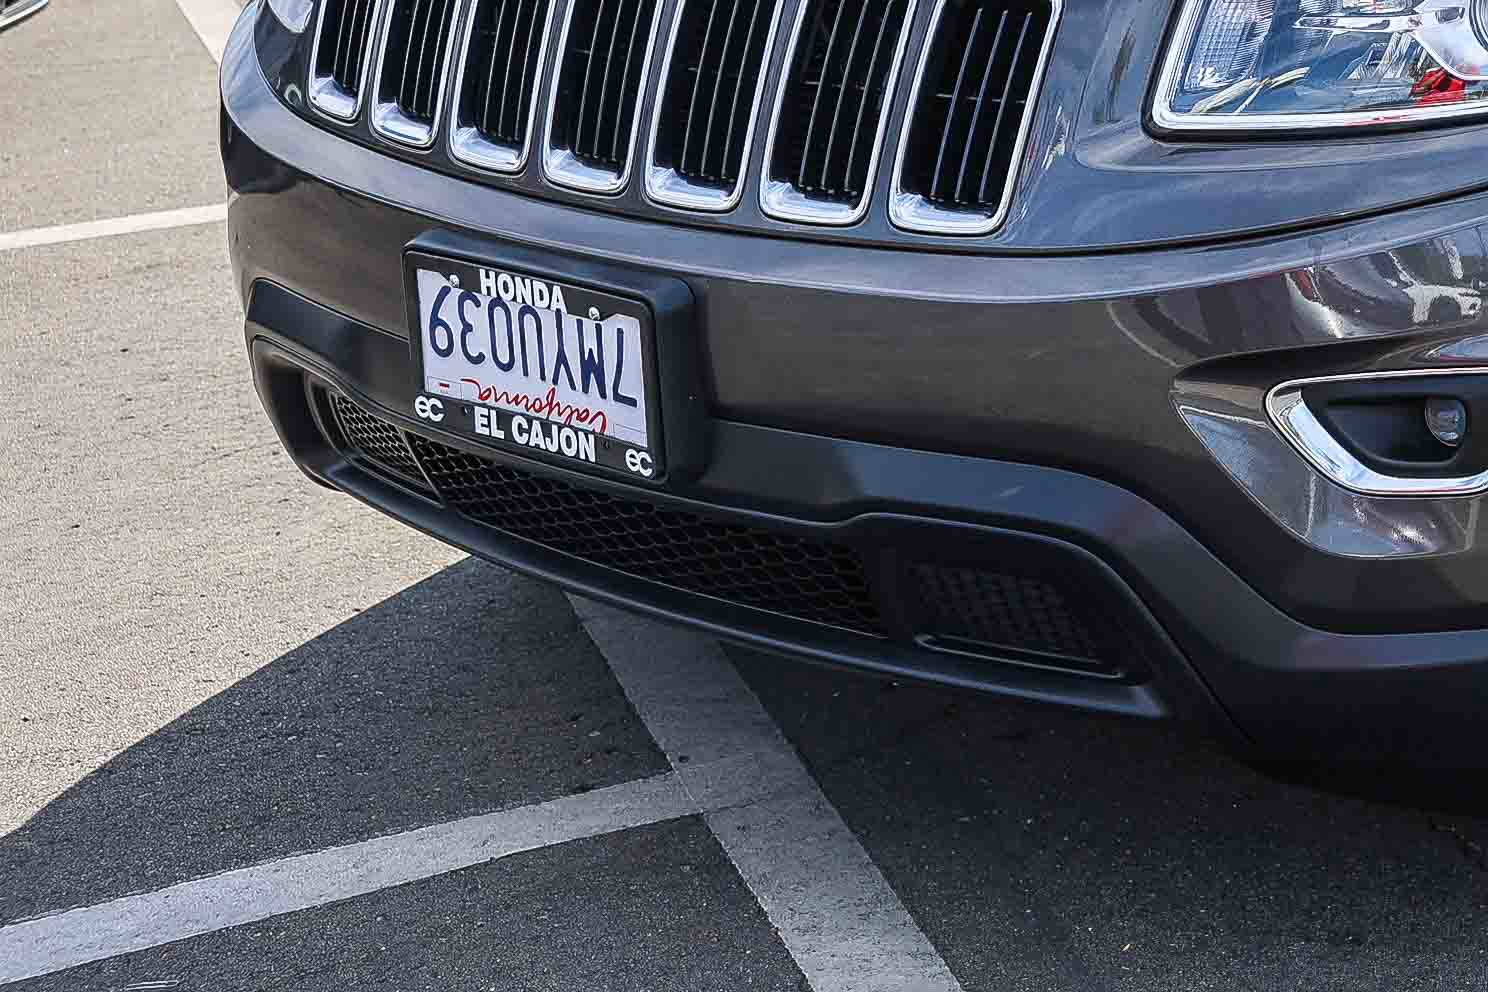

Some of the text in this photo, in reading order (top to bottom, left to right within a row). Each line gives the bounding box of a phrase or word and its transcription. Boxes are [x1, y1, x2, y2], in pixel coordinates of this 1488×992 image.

[479, 269, 567, 314] HONDA
[474, 406, 596, 463] EL CAJON
